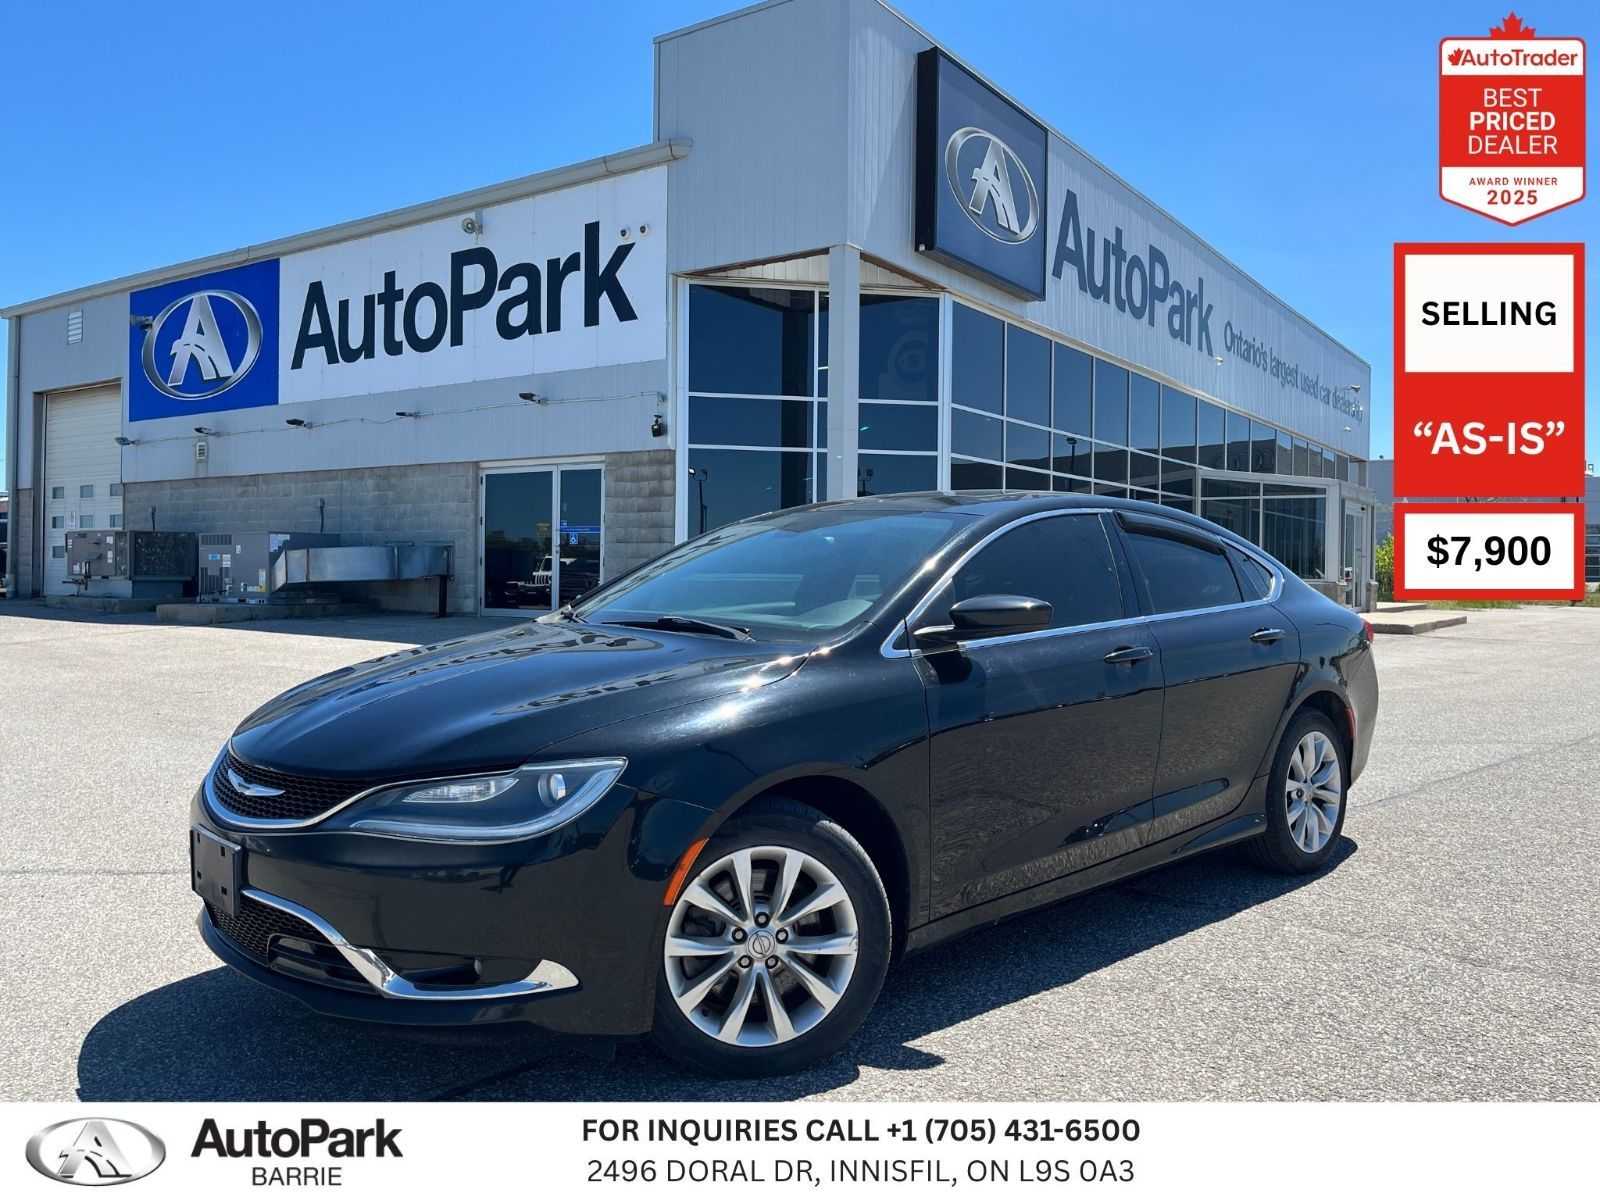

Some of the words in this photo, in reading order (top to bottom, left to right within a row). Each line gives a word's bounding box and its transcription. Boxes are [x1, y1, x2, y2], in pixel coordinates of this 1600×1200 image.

[290, 220, 639, 370] AutoPark
[1052, 189, 1214, 357] AutoPark
[1224, 320, 1268, 372] Ontario's
[1270, 347, 1299, 388] largest
[1300, 371, 1318, 400] used
[1320, 383, 1331, 405] car
